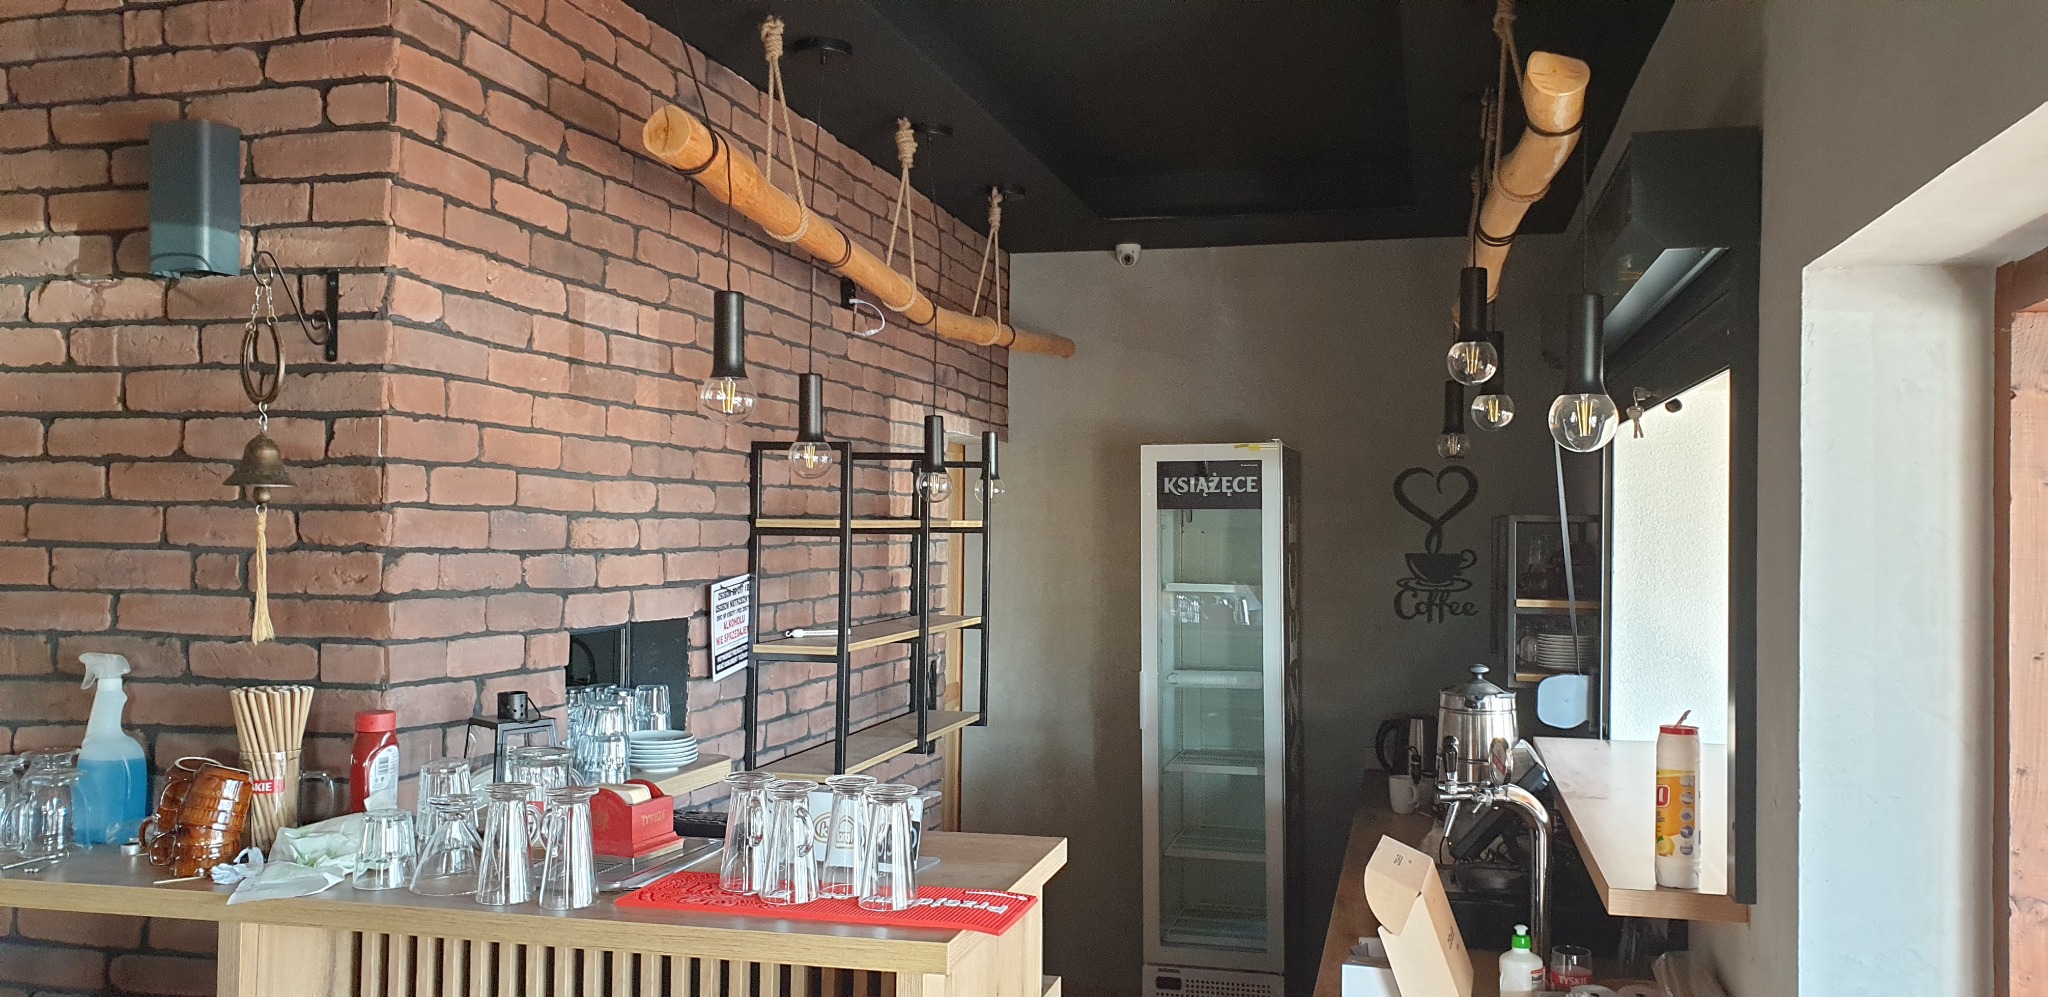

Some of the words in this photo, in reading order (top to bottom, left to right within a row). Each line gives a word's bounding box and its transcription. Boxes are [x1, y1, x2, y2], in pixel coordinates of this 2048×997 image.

[1164, 472, 1258, 496] KSIĄŻĘCE
[1394, 588, 1478, 623] Coffee
[724, 614, 745, 630] ALKOHOLU
[1558, 975, 1588, 985] TYSKIE
